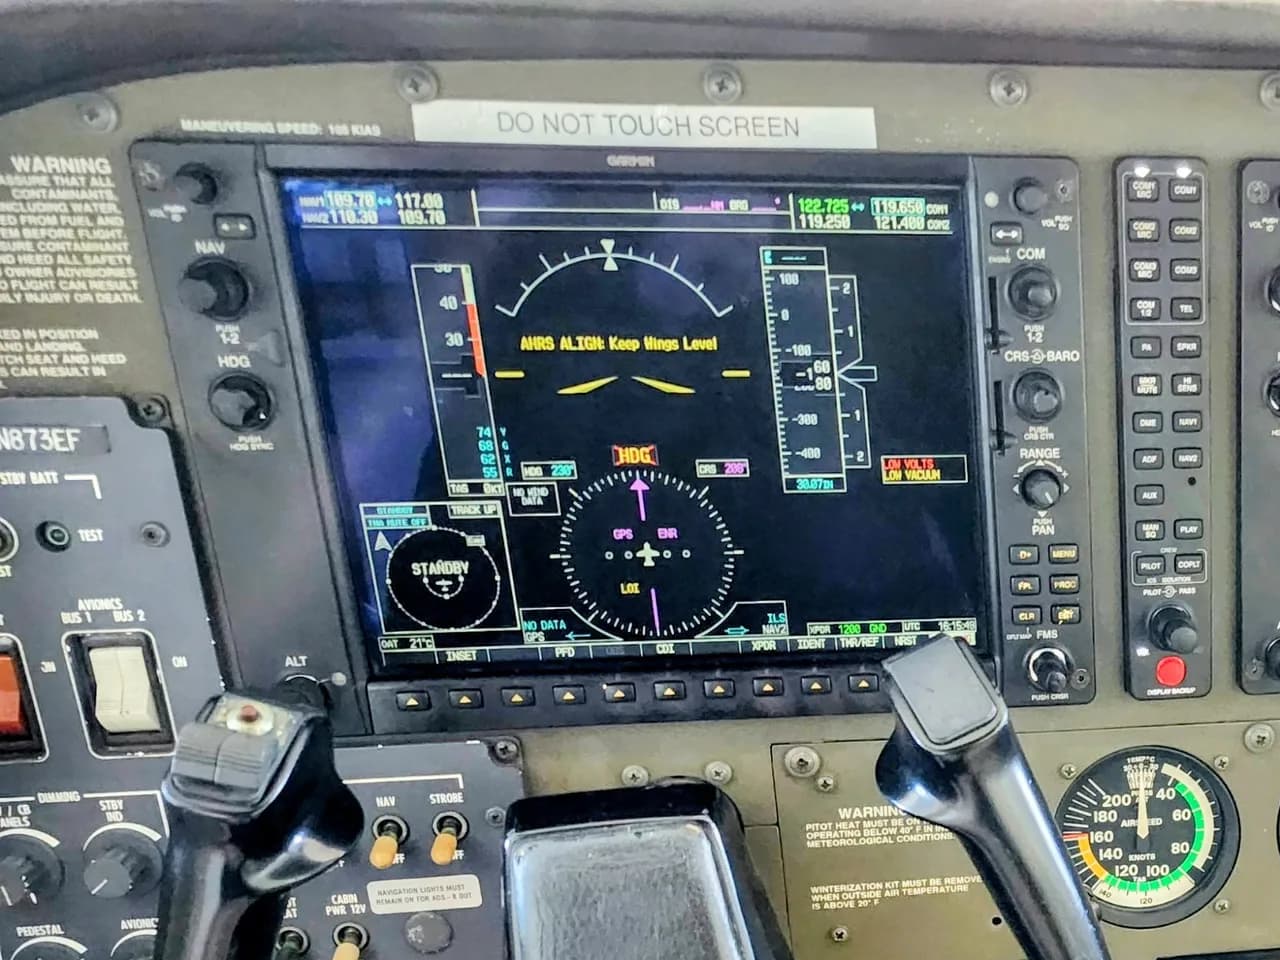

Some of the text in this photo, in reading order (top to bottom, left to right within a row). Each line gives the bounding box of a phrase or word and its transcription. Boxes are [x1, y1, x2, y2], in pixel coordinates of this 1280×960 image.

[498, 112, 801, 138] DO NOT TOUCH SCREEN
[10, 155, 112, 174] WARNING
[798, 198, 924, 214] 122.725 119.650
[799, 215, 850, 229] 119.250
[195, 241, 226, 255] NAV
[1017, 248, 1046, 260] COM
[439, 296, 458, 310] 40
[520, 336, 555, 350] AHRS
[609, 336, 640, 352] Keep
[683, 336, 718, 350] Level
[1047, 350, 1080, 361] BARO
[218, 356, 251, 369] HDG
[617, 448, 652, 464] HDG
[1020, 448, 1060, 459] RANGE
[904, 459, 934, 470] VOLTS
[30, 471, 59, 484] BATT
[907, 470, 941, 481] VACUUM
[78, 529, 103, 542] TEST
[613, 527, 678, 540] GPS ENR
[1032, 525, 1055, 536] PAN
[411, 562, 470, 576] STANDBY
[78, 598, 123, 611] AVIONICS
[61, 610, 146, 624] BUS 1 BUS 2
[525, 620, 567, 631] NO DATA
[1036, 630, 1058, 640] FMS
[797, 638, 826, 649] IDENT
[285, 656, 307, 668] ALT
[446, 652, 477, 661] INSET
[37, 791, 81, 803] DIMMING
[429, 793, 464, 804] STROBE
[1156, 788, 1176, 800] 40
[99, 800, 124, 811] STBY
[376, 796, 396, 807] NAV
[1102, 795, 1131, 808] 200
[106, 811, 124, 822] IND
[1094, 811, 1118, 823] 180
[1172, 809, 1192, 821] 60
[806, 819, 904, 832] PITOT HEAT MUST BE
[806, 837, 894, 848] METEOROLOGICAL
[1090, 831, 1114, 844] 160
[1099, 848, 1123, 860] 140
[1171, 842, 1190, 854] 80
[1128, 853, 1156, 862] KNOTS
[1115, 865, 1170, 877] 120 100
[810, 878, 943, 894] WINTERIZATION KIT MUST BE
[811, 884, 969, 902] WHEN OUTSIDE AIR TEMPERATURE
[331, 894, 358, 905] CABIN
[812, 901, 855, 910] IS ABOVE
[326, 904, 366, 916] PWR 12V
[16, 925, 64, 937] PEDESTAL
